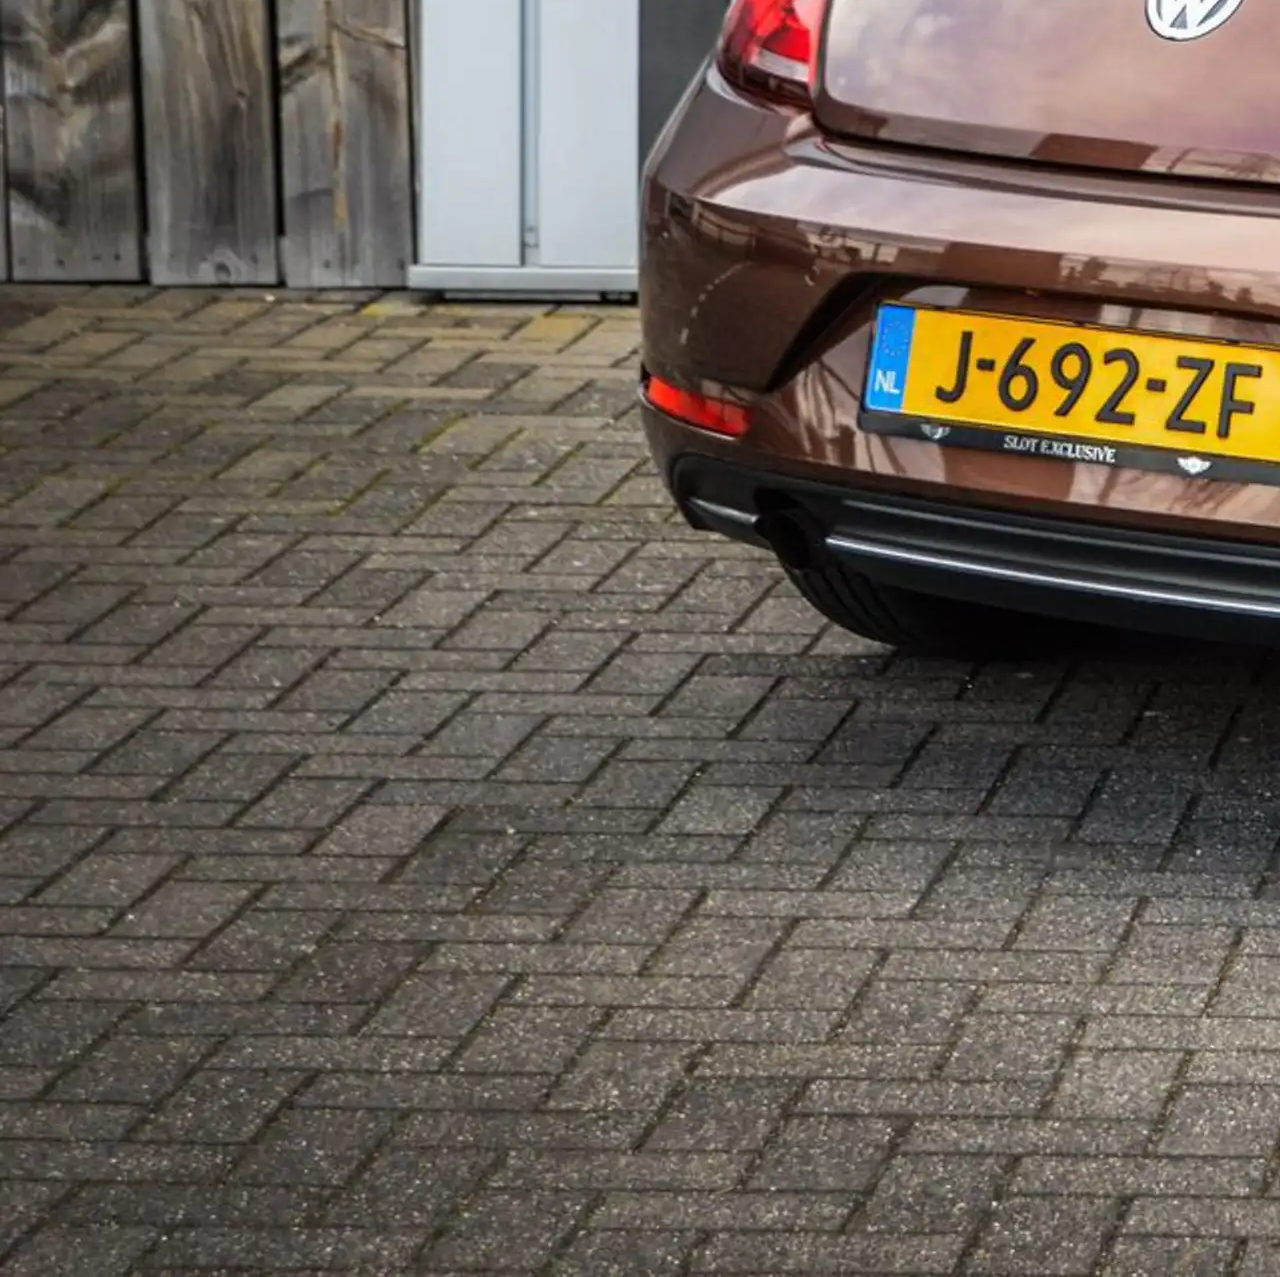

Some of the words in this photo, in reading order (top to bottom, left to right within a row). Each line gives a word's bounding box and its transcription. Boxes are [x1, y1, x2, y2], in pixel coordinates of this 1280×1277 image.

[873, 368, 901, 395] NL
[934, 330, 1263, 439] J-692-ZF
[1003, 434, 1039, 453] SLOT
[1040, 439, 1117, 463] EXCLUSIVE
